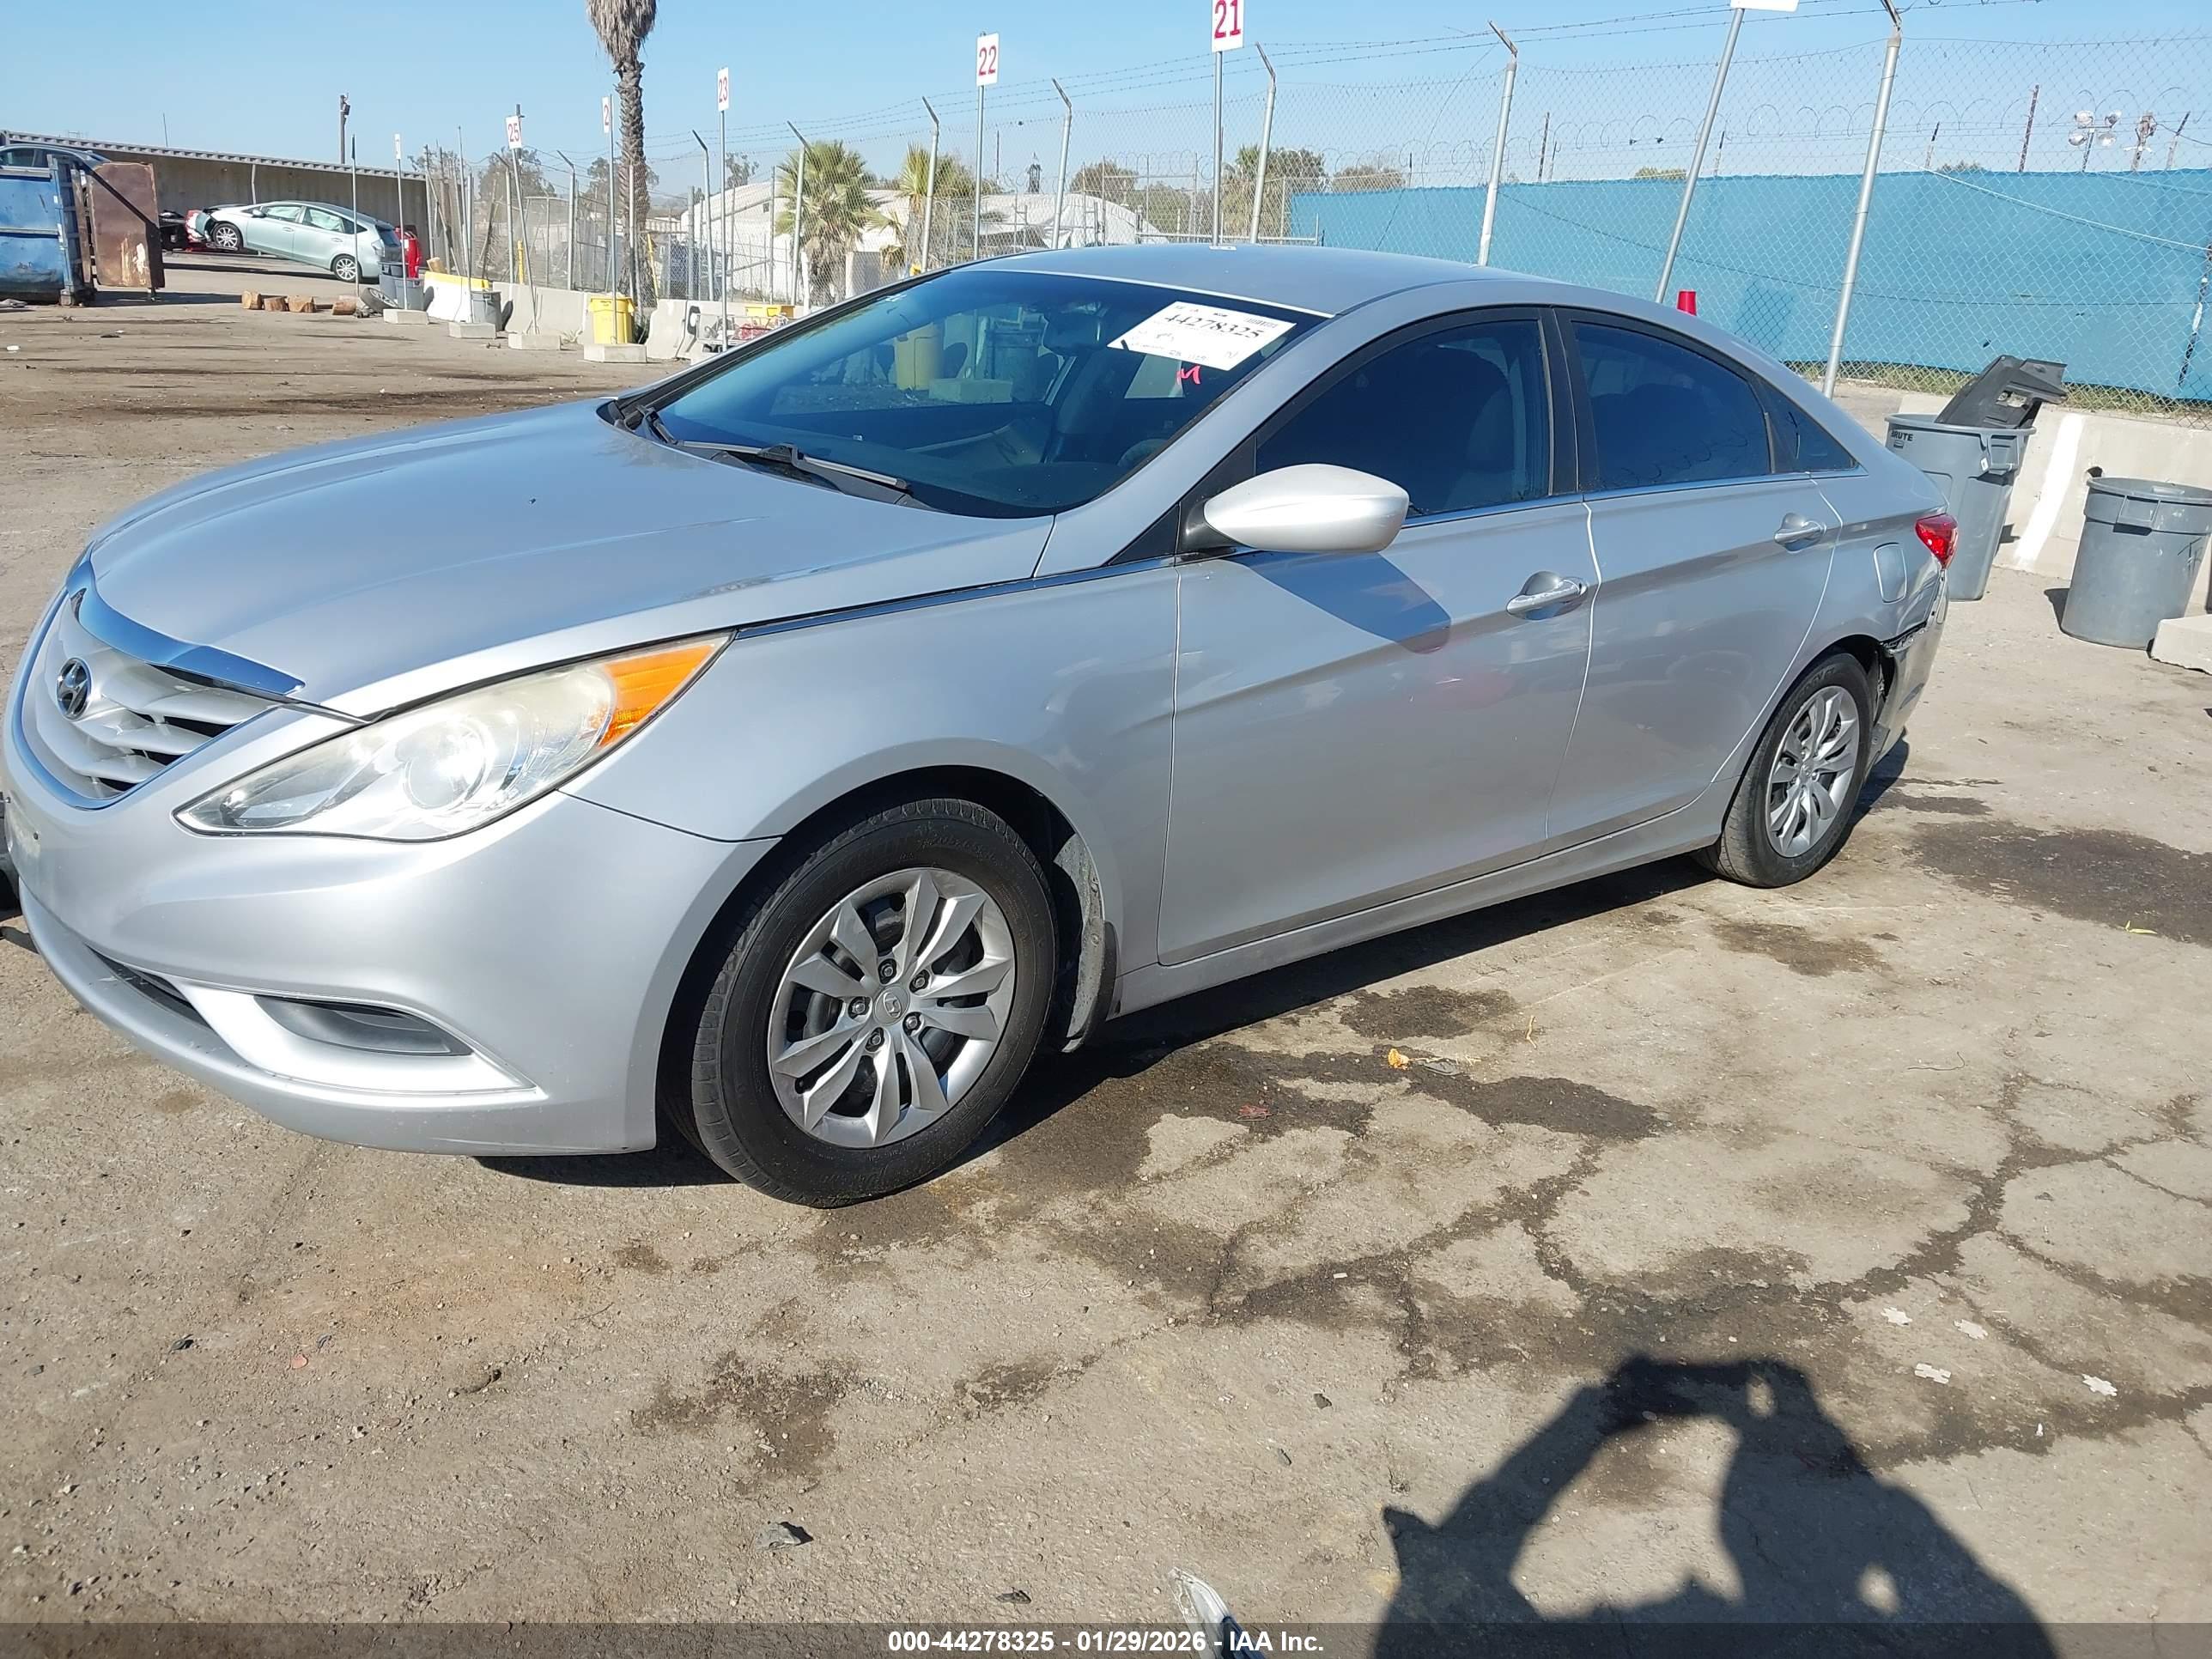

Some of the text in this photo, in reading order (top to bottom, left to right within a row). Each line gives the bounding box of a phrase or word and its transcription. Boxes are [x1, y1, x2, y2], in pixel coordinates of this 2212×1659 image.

[1213, 0, 1241, 39] 21
[978, 46, 997, 76] 22
[719, 76, 728, 103] 23
[507, 122, 520, 143] 25
[1164, 313, 1265, 339] 44278325
[1891, 430, 1913, 441] BRUTE
